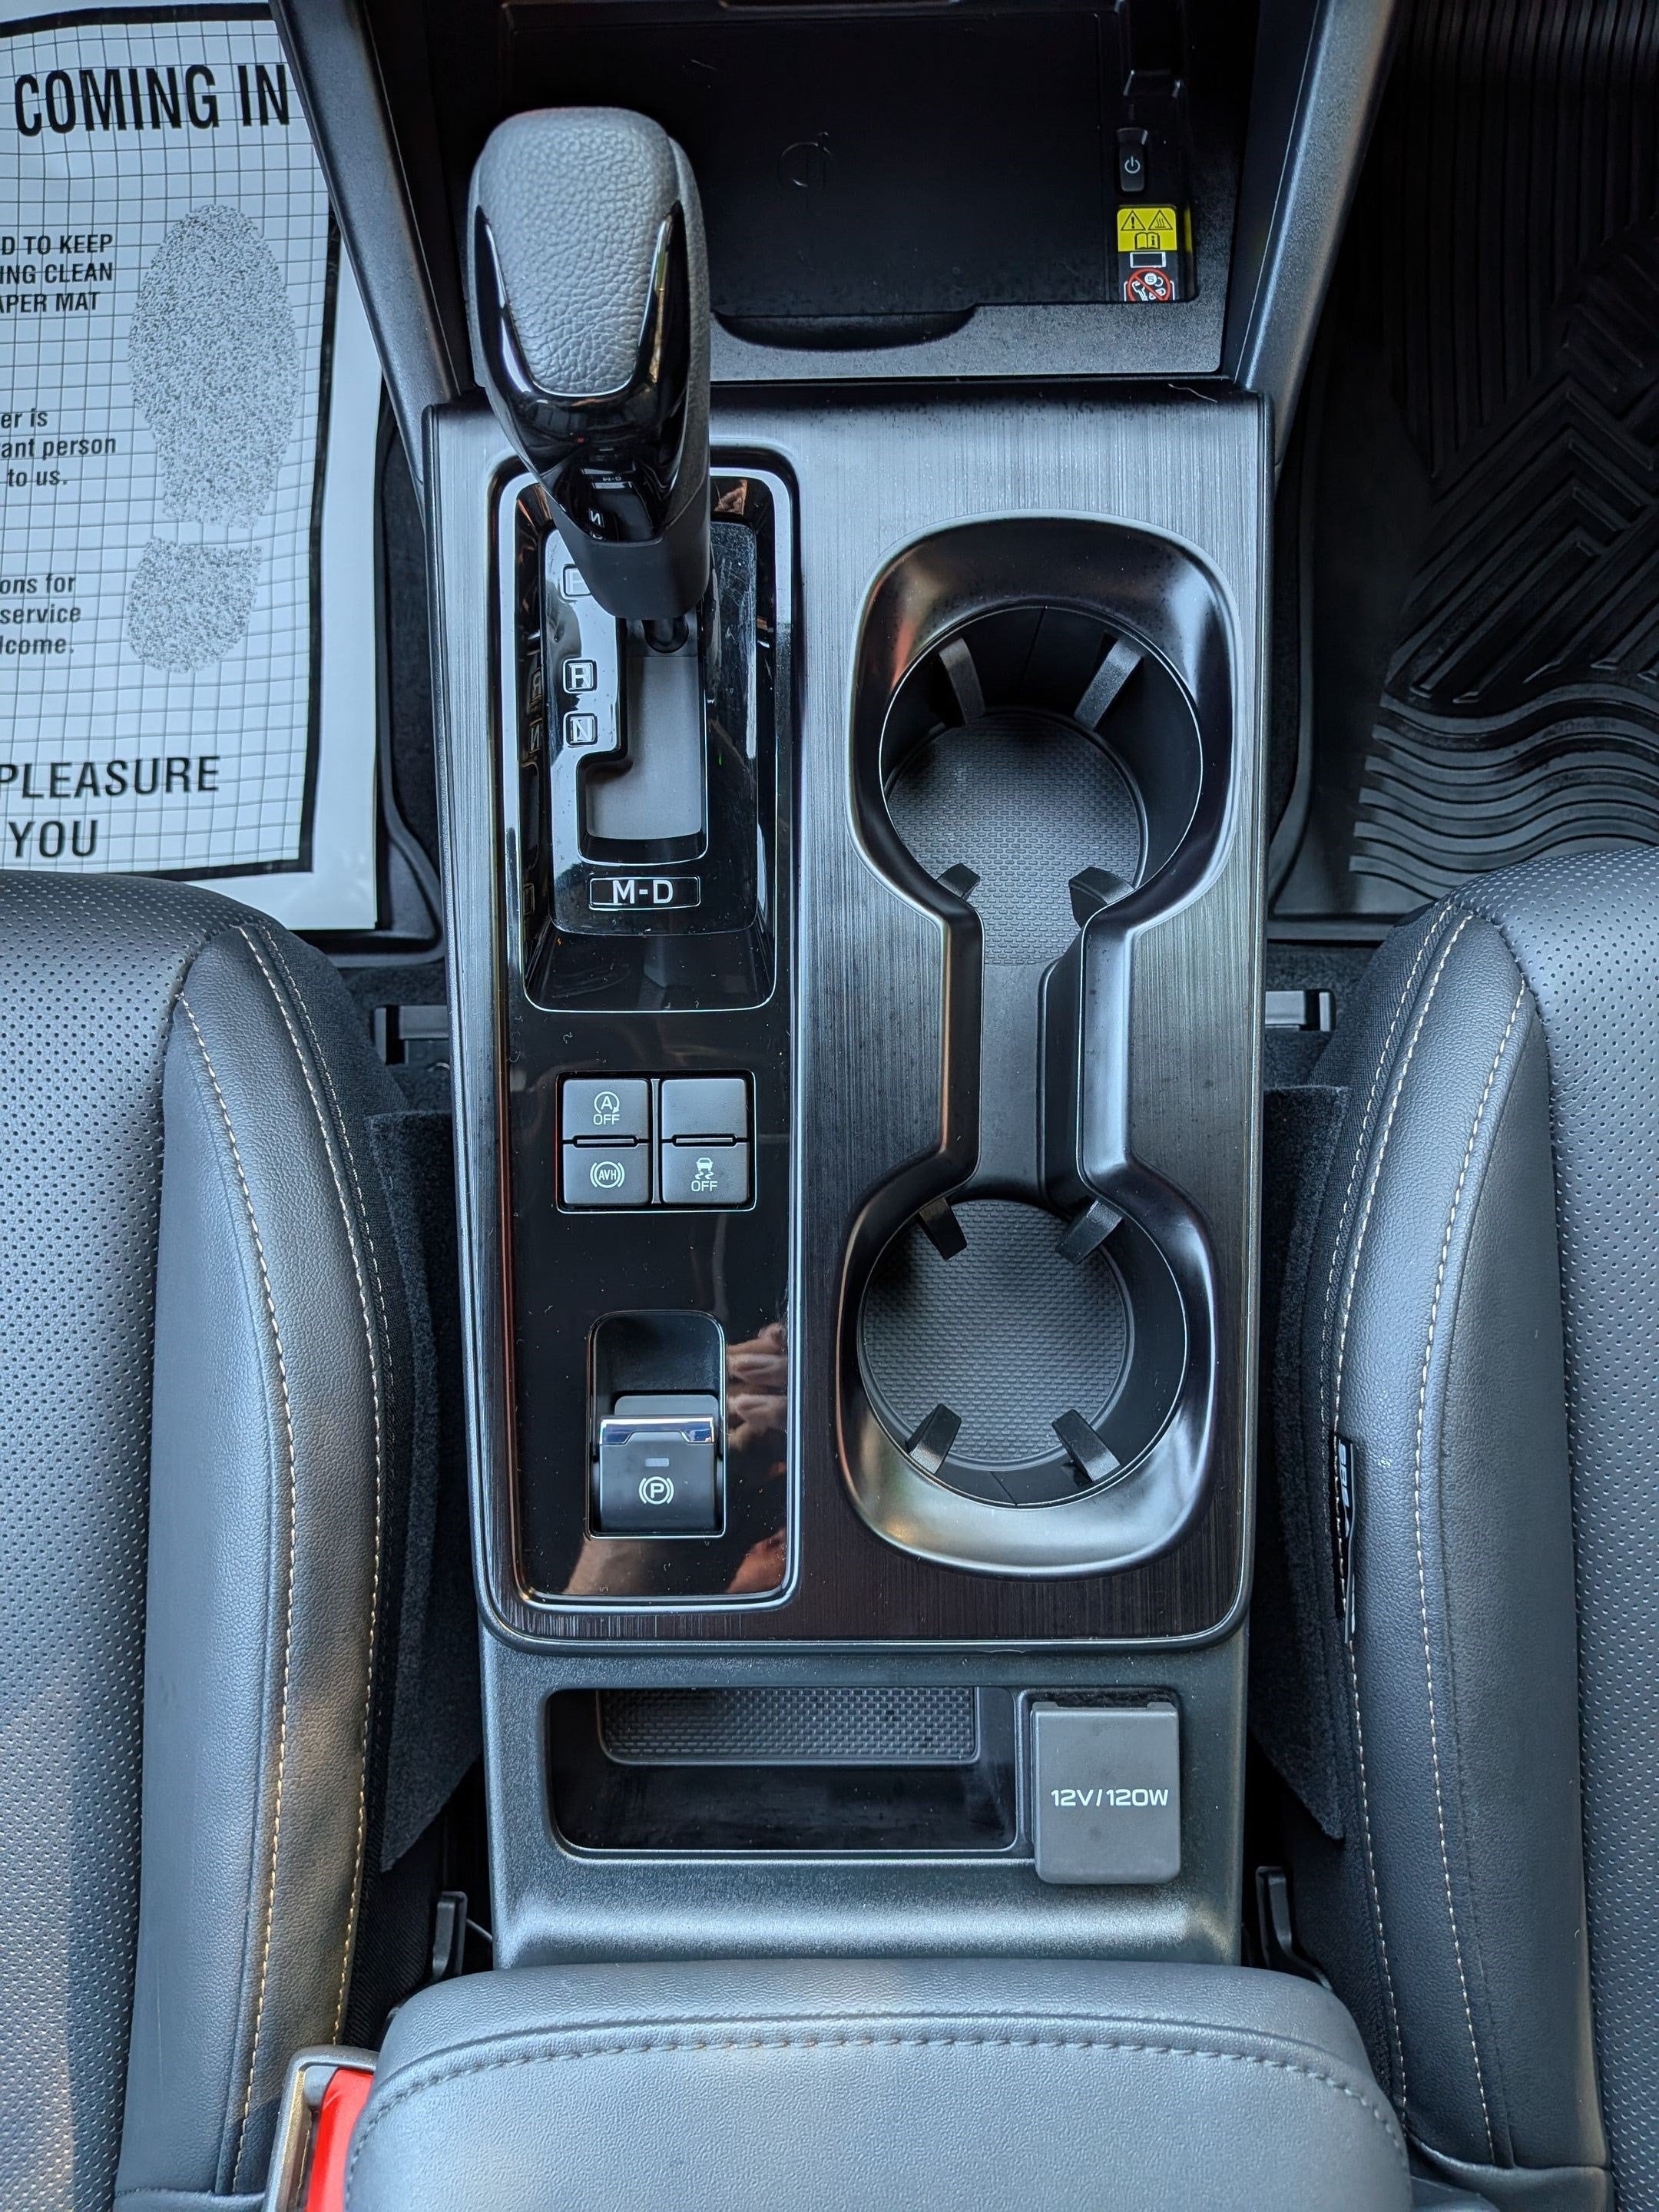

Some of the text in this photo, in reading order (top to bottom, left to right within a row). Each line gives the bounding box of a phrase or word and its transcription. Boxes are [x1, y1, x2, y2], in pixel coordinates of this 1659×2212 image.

[15, 63, 290, 137] COMING IN
[23, 235, 51, 255] TO
[59, 233, 113, 254] KEEP
[45, 262, 113, 283] CLEAN
[55, 291, 100, 312] MAT
[30, 408, 48, 427] is
[42, 438, 116, 461] person
[8, 469, 68, 487] to us.
[46, 573, 75, 593] for
[0, 604, 81, 624] service
[571, 664, 591, 688] R
[572, 717, 592, 742] N
[8, 820, 98, 858] YOU
[612, 879, 674, 904] M-D
[593, 1113, 620, 1125] OFF
[598, 1168, 617, 1181] AVH
[691, 1181, 717, 1192] OFF
[651, 1482, 664, 1498] P
[1051, 1788, 1168, 1806] 12V/120W
